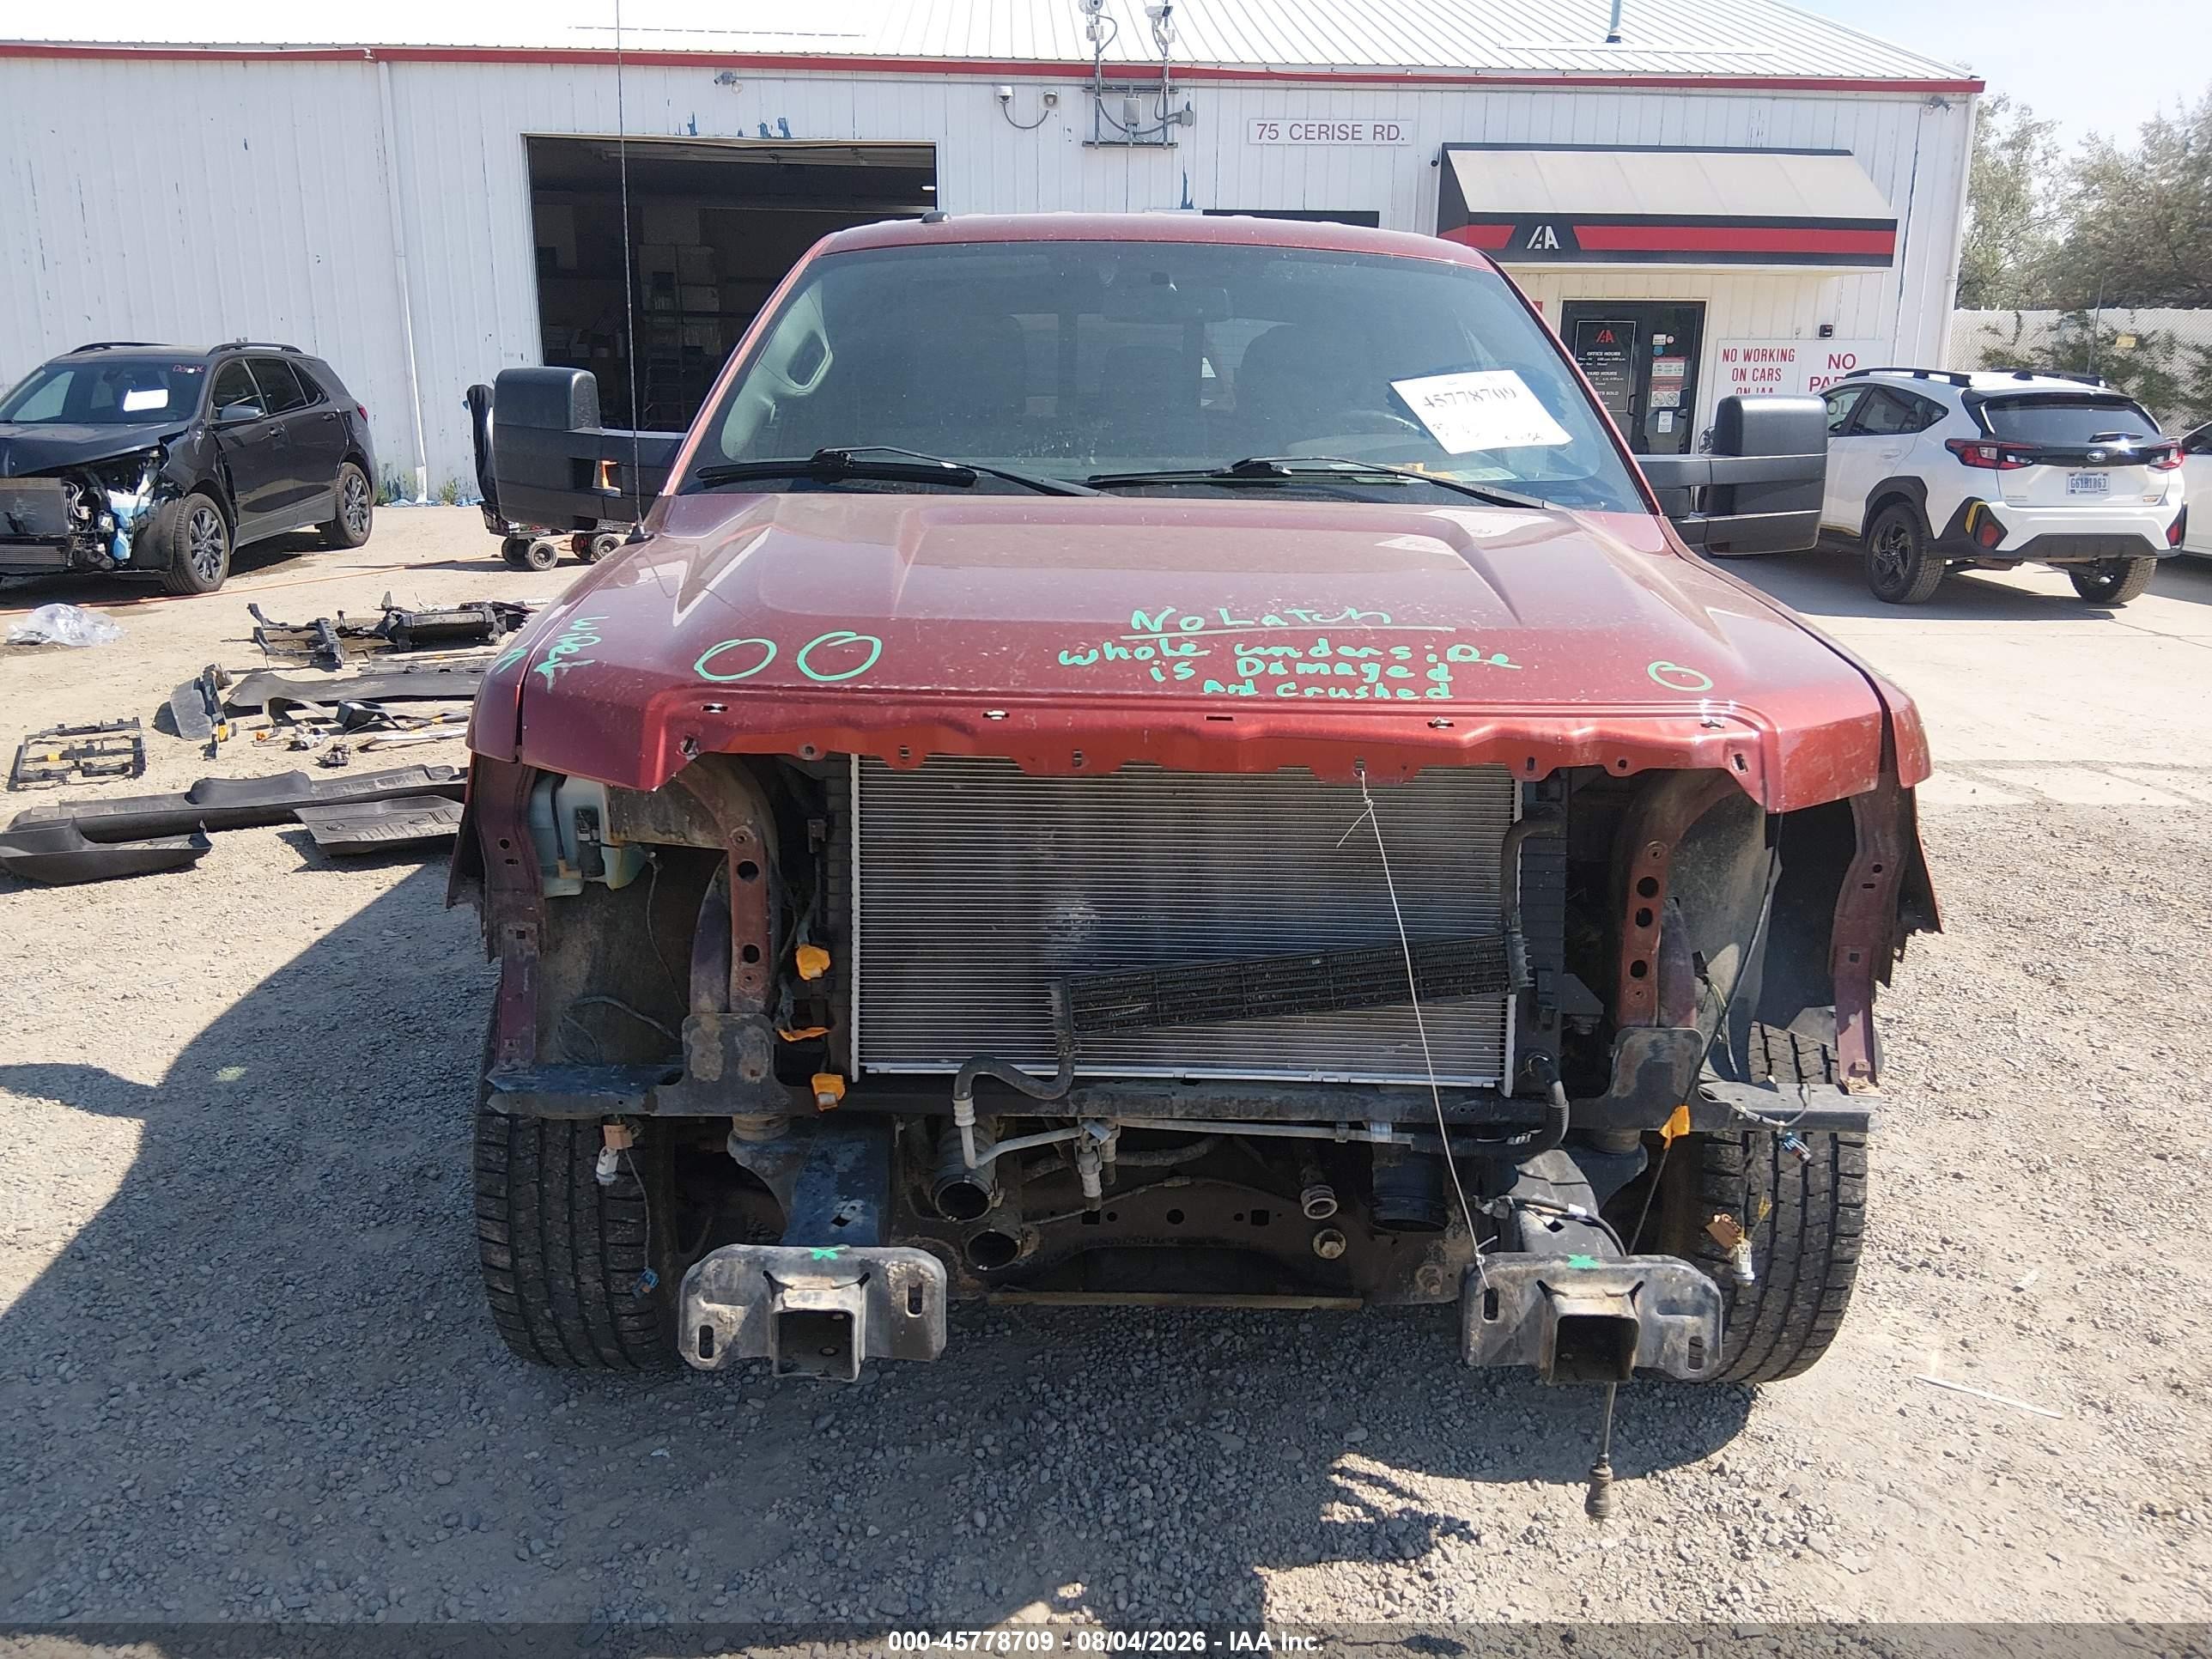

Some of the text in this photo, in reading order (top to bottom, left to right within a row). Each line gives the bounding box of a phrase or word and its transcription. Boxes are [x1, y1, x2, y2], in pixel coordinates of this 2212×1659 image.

[1256, 123, 1406, 141] 75 CERISE RD.
[1722, 348, 1796, 362] NO WORKING
[1827, 353, 1856, 370] NO
[1731, 368, 1782, 381] ON CARS
[1150, 660, 1196, 682] is
